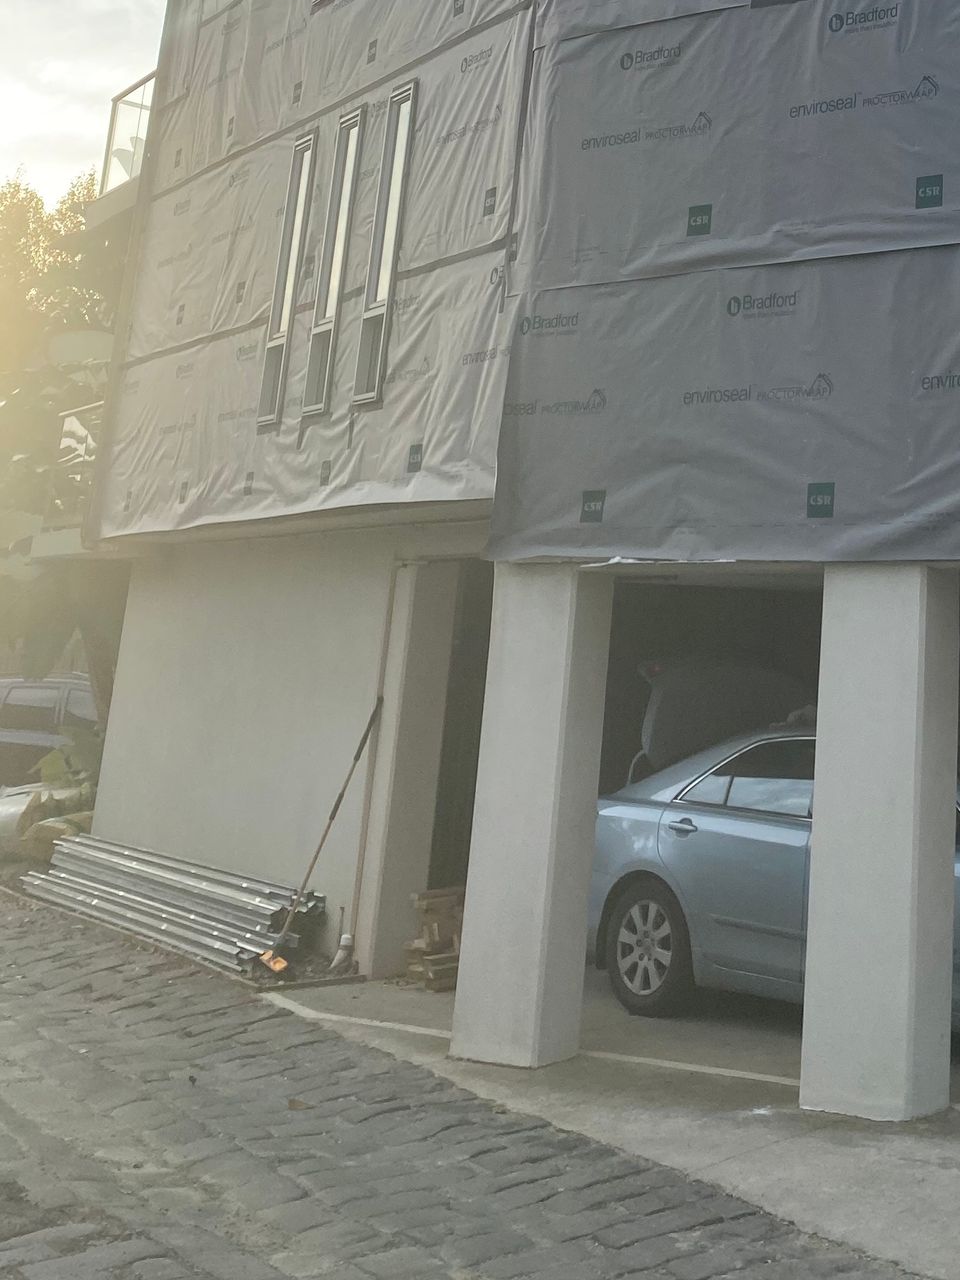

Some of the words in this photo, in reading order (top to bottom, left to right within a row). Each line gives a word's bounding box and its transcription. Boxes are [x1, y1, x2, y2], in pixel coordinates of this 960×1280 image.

[846, 3, 898, 26] Bradford
[635, 42, 682, 65] Bradford
[790, 93, 857, 119] enviroseal
[581, 129, 641, 151] enviroseal
[918, 185, 940, 197] CSR
[690, 216, 709, 226] CSR
[743, 292, 797, 311] Bradford
[533, 312, 579, 330] Bradford
[683, 384, 751, 405] enviroseal
[810, 494, 832, 505] CSR
